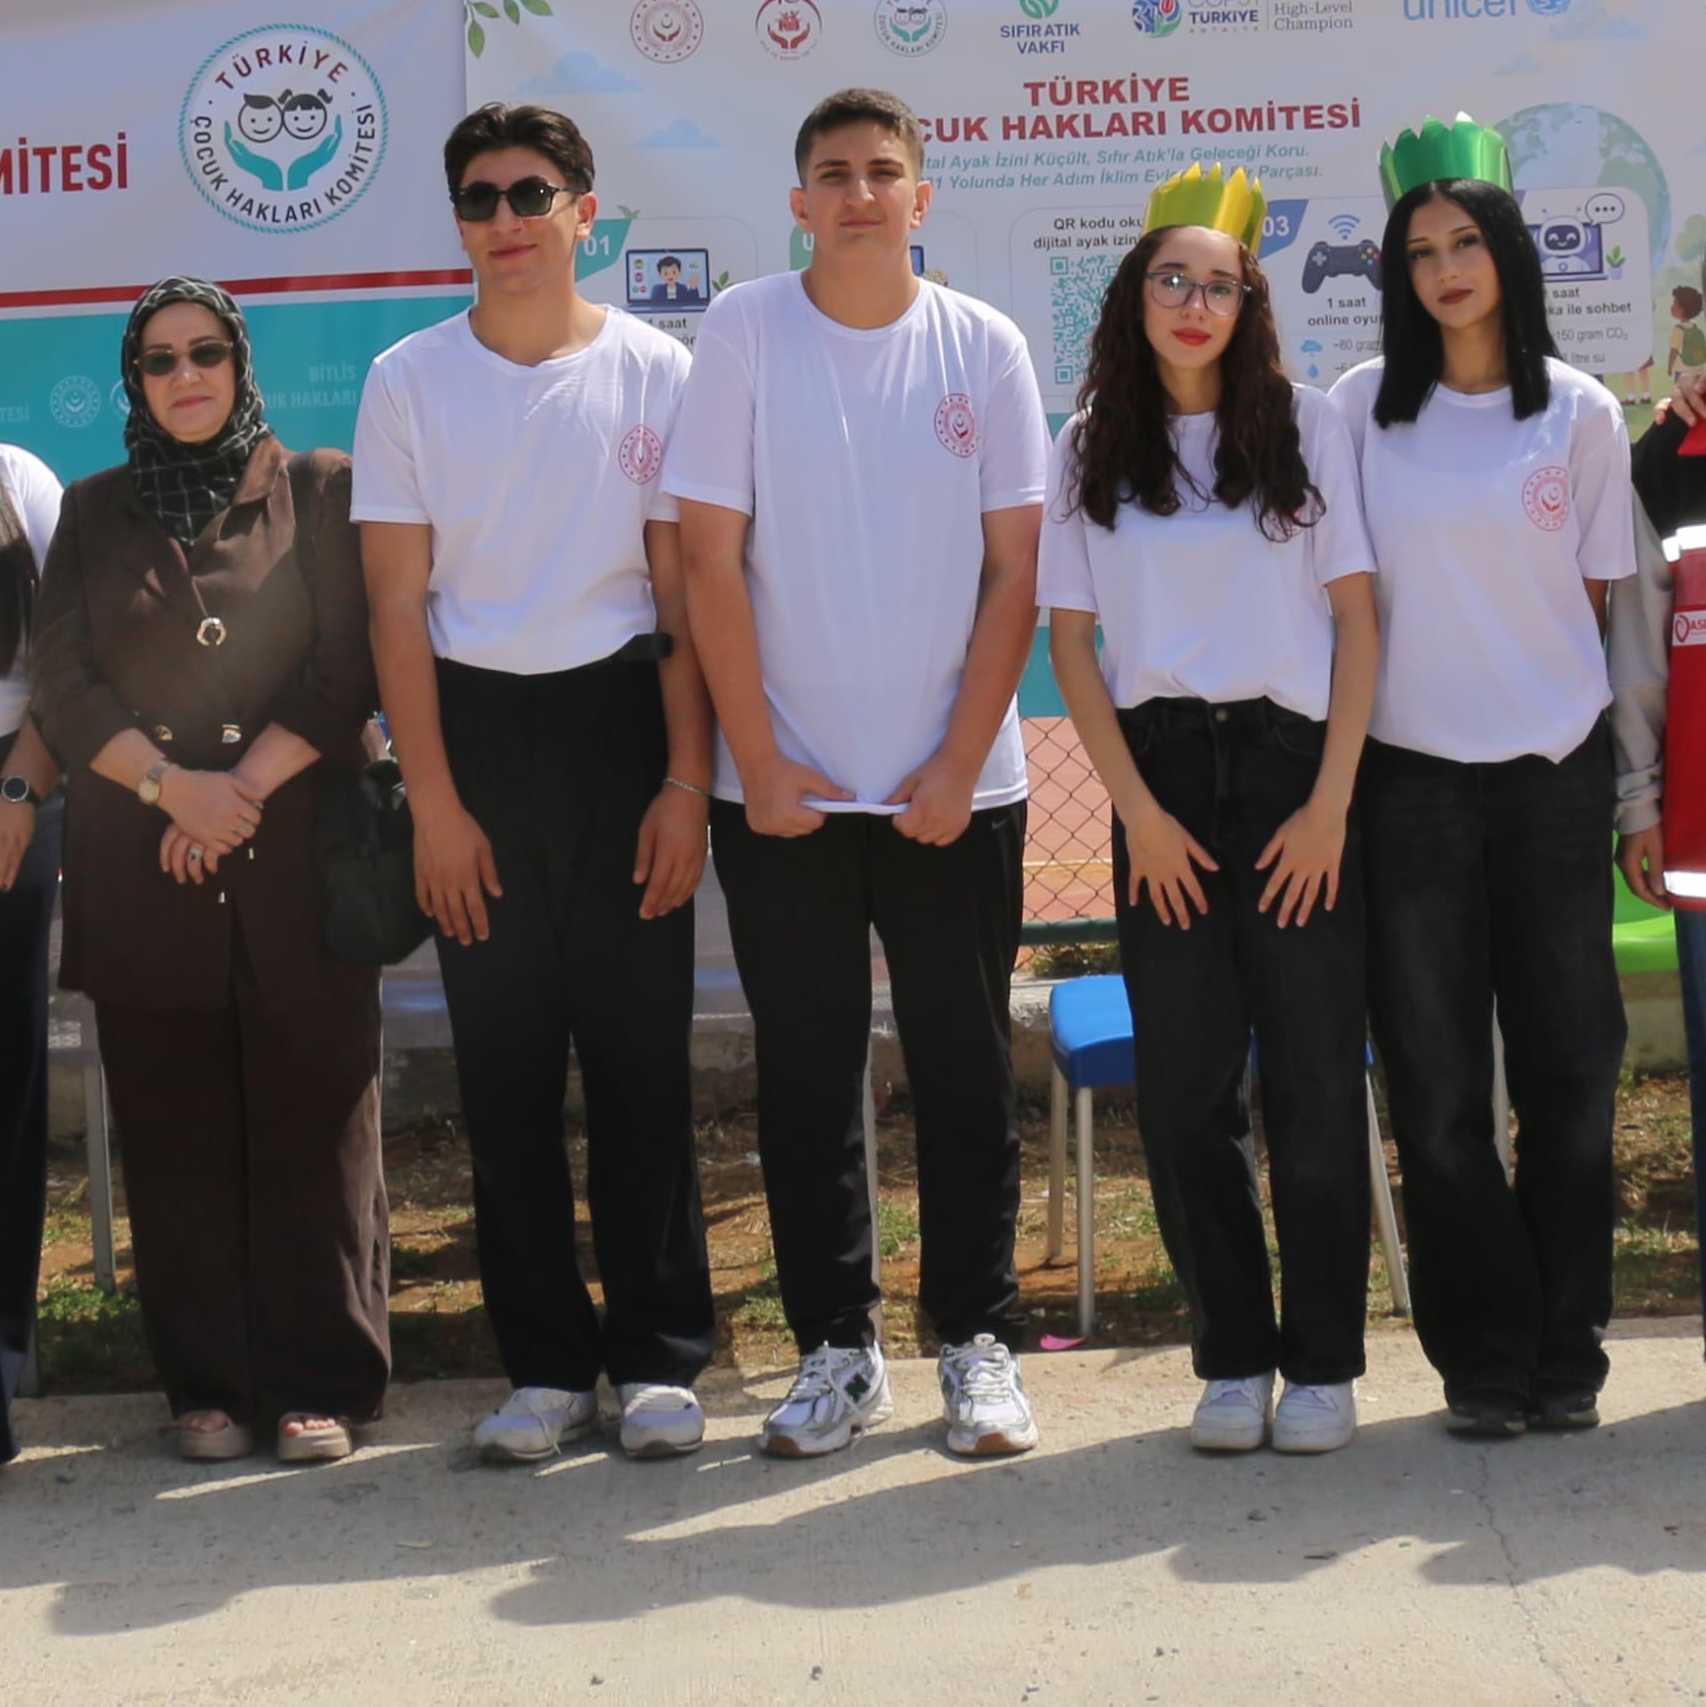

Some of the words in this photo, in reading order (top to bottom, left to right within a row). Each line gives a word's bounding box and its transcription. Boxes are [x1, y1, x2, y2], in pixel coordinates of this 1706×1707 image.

[1274, 0, 1353, 18] High-Level
[1000, 24, 1042, 38] SIFIR
[1044, 23, 1081, 37] ATIK
[1274, 17, 1353, 33] Champion
[1016, 40, 1065, 54] VAKFI
[215, 41, 349, 90] TÜRKİYE
[1023, 72, 1190, 107] TÜRKİYE
[1002, 110, 1167, 141] HAKLARI
[1181, 97, 1361, 134] KOMİTESİ
[190, 116, 229, 191] ÇOCUK
[225, 188, 322, 223] HAKLARI
[324, 104, 375, 206] KOMİTESİ
[949, 154, 990, 171] Ayak
[995, 151, 1029, 168] İzini
[1033, 151, 1091, 169] Küçült,
[1189, 144, 1262, 162] Geleceği
[1265, 144, 1310, 159] Koru.
[949, 174, 1015, 190] Yolunda
[1020, 172, 1049, 188] Her
[1052, 171, 1094, 187] Adım
[1100, 168, 1139, 185] İklim
[1053, 218, 1076, 230] QR
[1080, 216, 1115, 229] kodu
[1263, 215, 1290, 237] 03
[583, 234, 611, 257] 01
[1033, 236, 1072, 251] dijital
[1076, 235, 1110, 250] ayak
[1552, 287, 1580, 299] saat
[1327, 297, 1333, 308] 1
[1338, 297, 1367, 308] saat
[1567, 304, 1584, 315] ile
[1586, 302, 1633, 315] sohbet
[659, 317, 687, 329] saat
[1307, 314, 1349, 327] online
